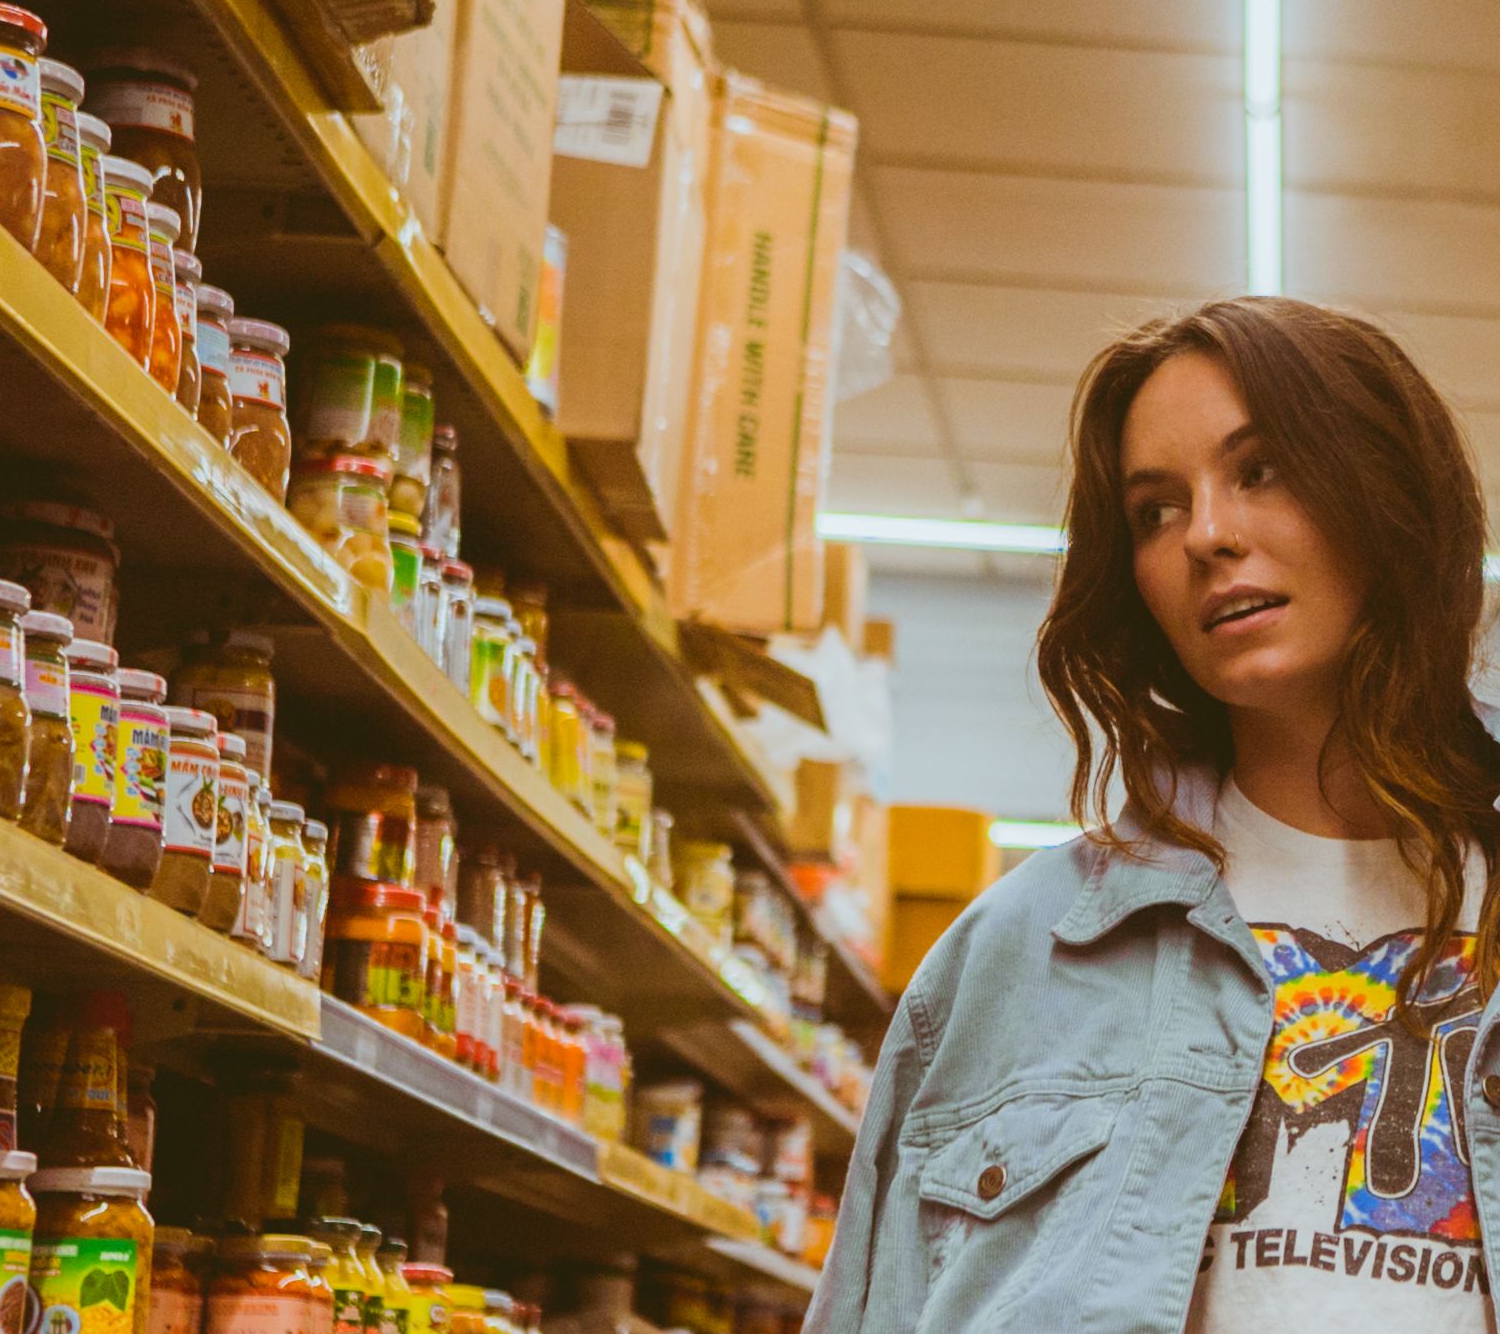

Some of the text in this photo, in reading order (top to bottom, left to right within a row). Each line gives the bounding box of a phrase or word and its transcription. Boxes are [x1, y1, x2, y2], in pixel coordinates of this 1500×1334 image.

[736, 231, 773, 481] HANDLE WITH CARE
[1230, 1228, 1490, 1296] TELEVISION
